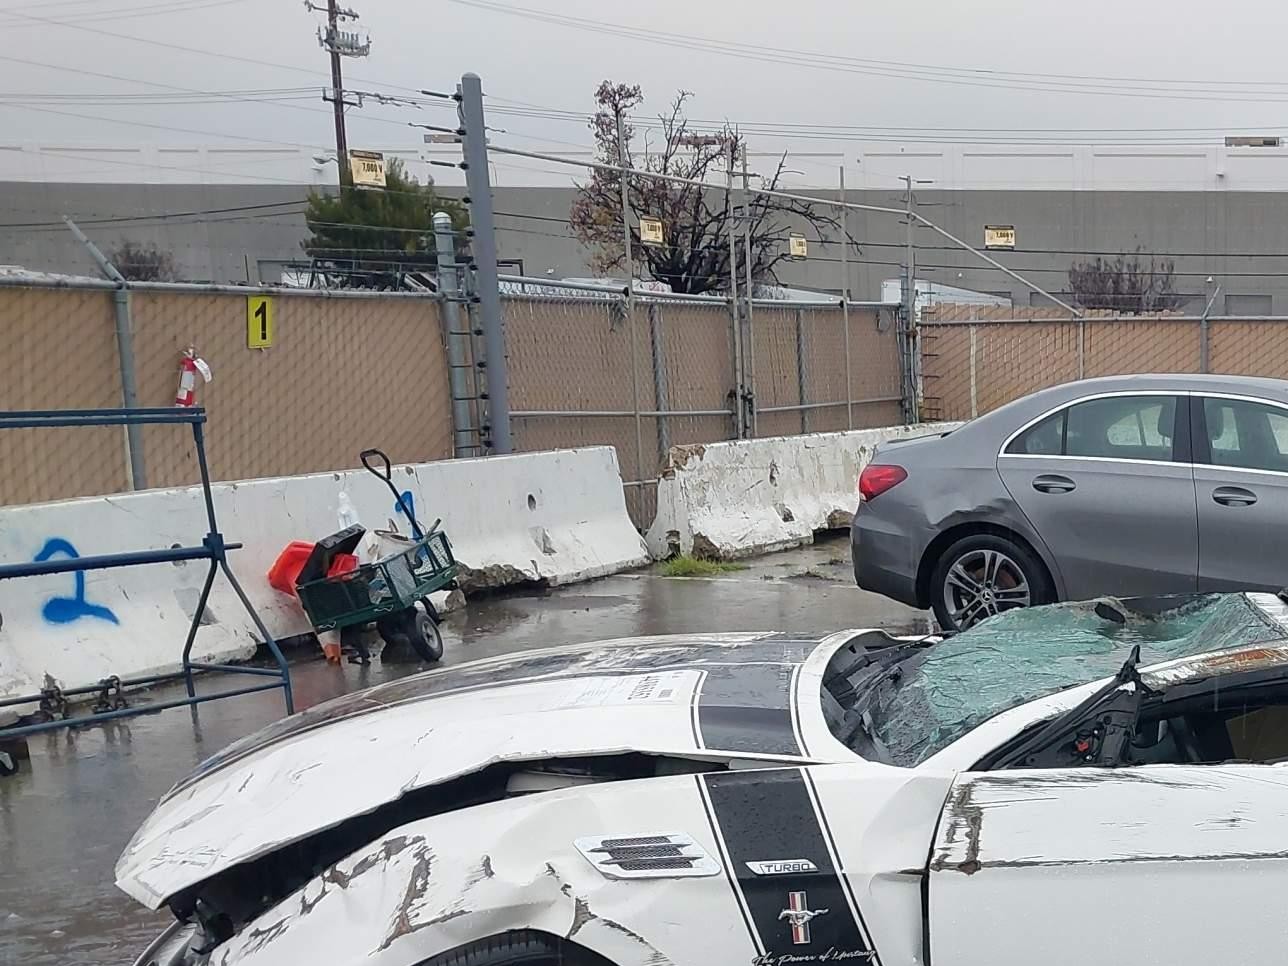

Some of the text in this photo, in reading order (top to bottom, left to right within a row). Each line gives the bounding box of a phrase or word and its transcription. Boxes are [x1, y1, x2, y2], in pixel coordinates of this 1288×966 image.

[255, 301, 267, 340] 1
[34, 538, 120, 625] 2
[764, 862, 811, 873] TURBO
[752, 951, 777, 966] The
[778, 954, 819, 966] Power
[819, 946, 834, 962] of
